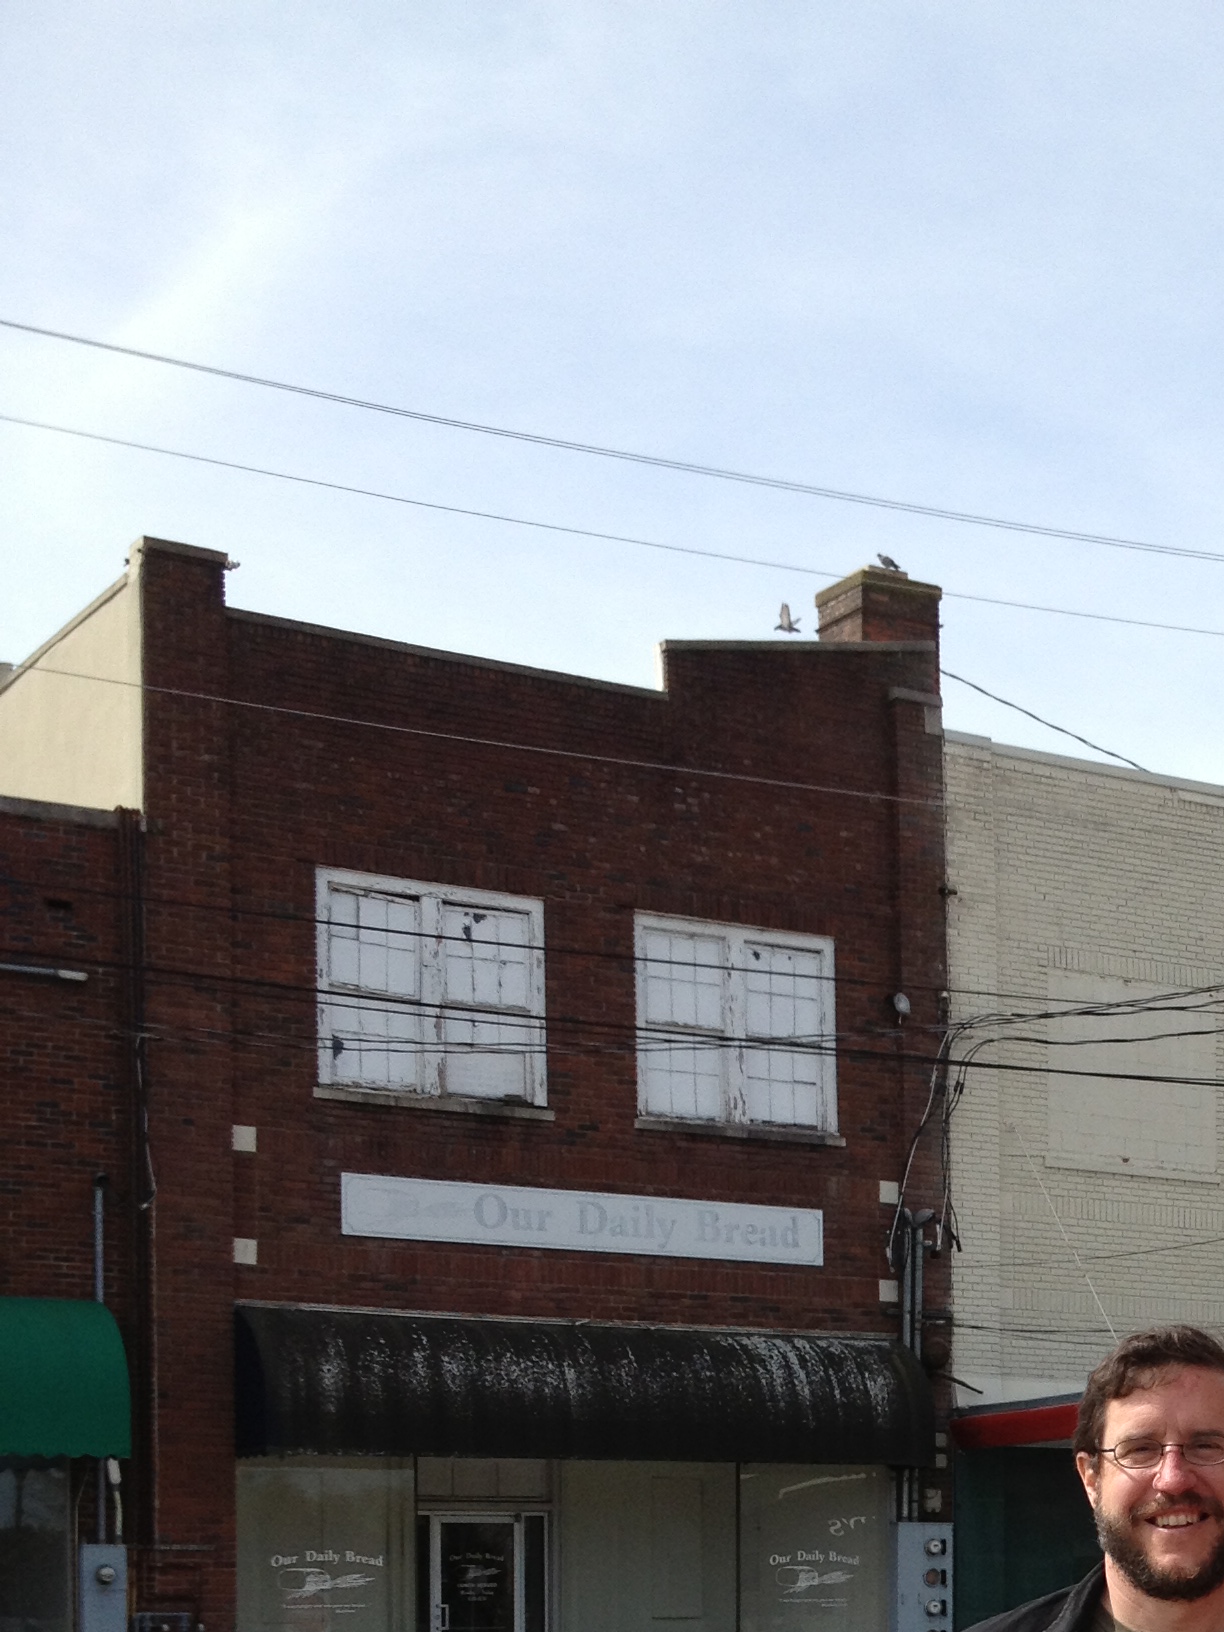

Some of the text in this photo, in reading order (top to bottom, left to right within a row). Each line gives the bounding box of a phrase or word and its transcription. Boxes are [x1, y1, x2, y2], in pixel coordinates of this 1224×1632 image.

[472, 1193, 802, 1250] Our Daily Bread
[271, 1549, 385, 1568] Our Daily Bread
[769, 1549, 860, 1566] Our Daily Bread
